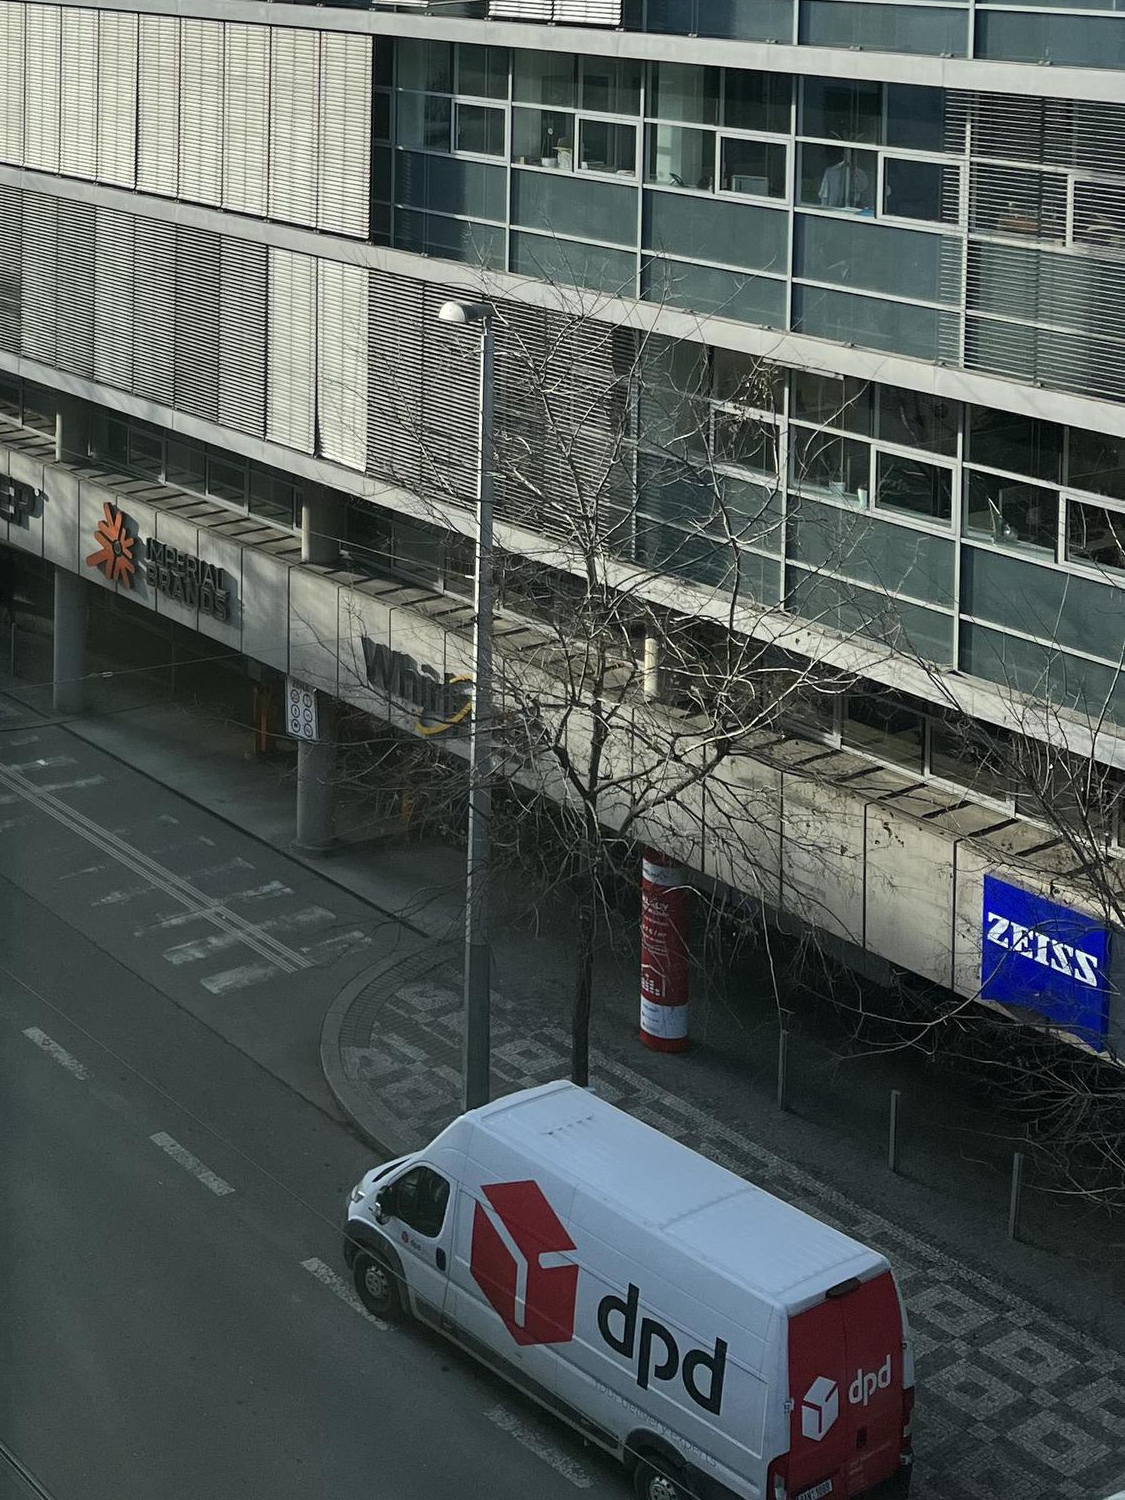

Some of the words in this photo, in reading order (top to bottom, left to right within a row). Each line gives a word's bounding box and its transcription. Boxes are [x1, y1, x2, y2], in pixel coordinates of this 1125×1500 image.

[145, 561, 229, 622] BRANDS
[146, 536, 227, 596] IMPERIAL
[986, 911, 1099, 988] ZEISS
[596, 1282, 728, 1415] dpd
[848, 1353, 893, 1406] dpd
